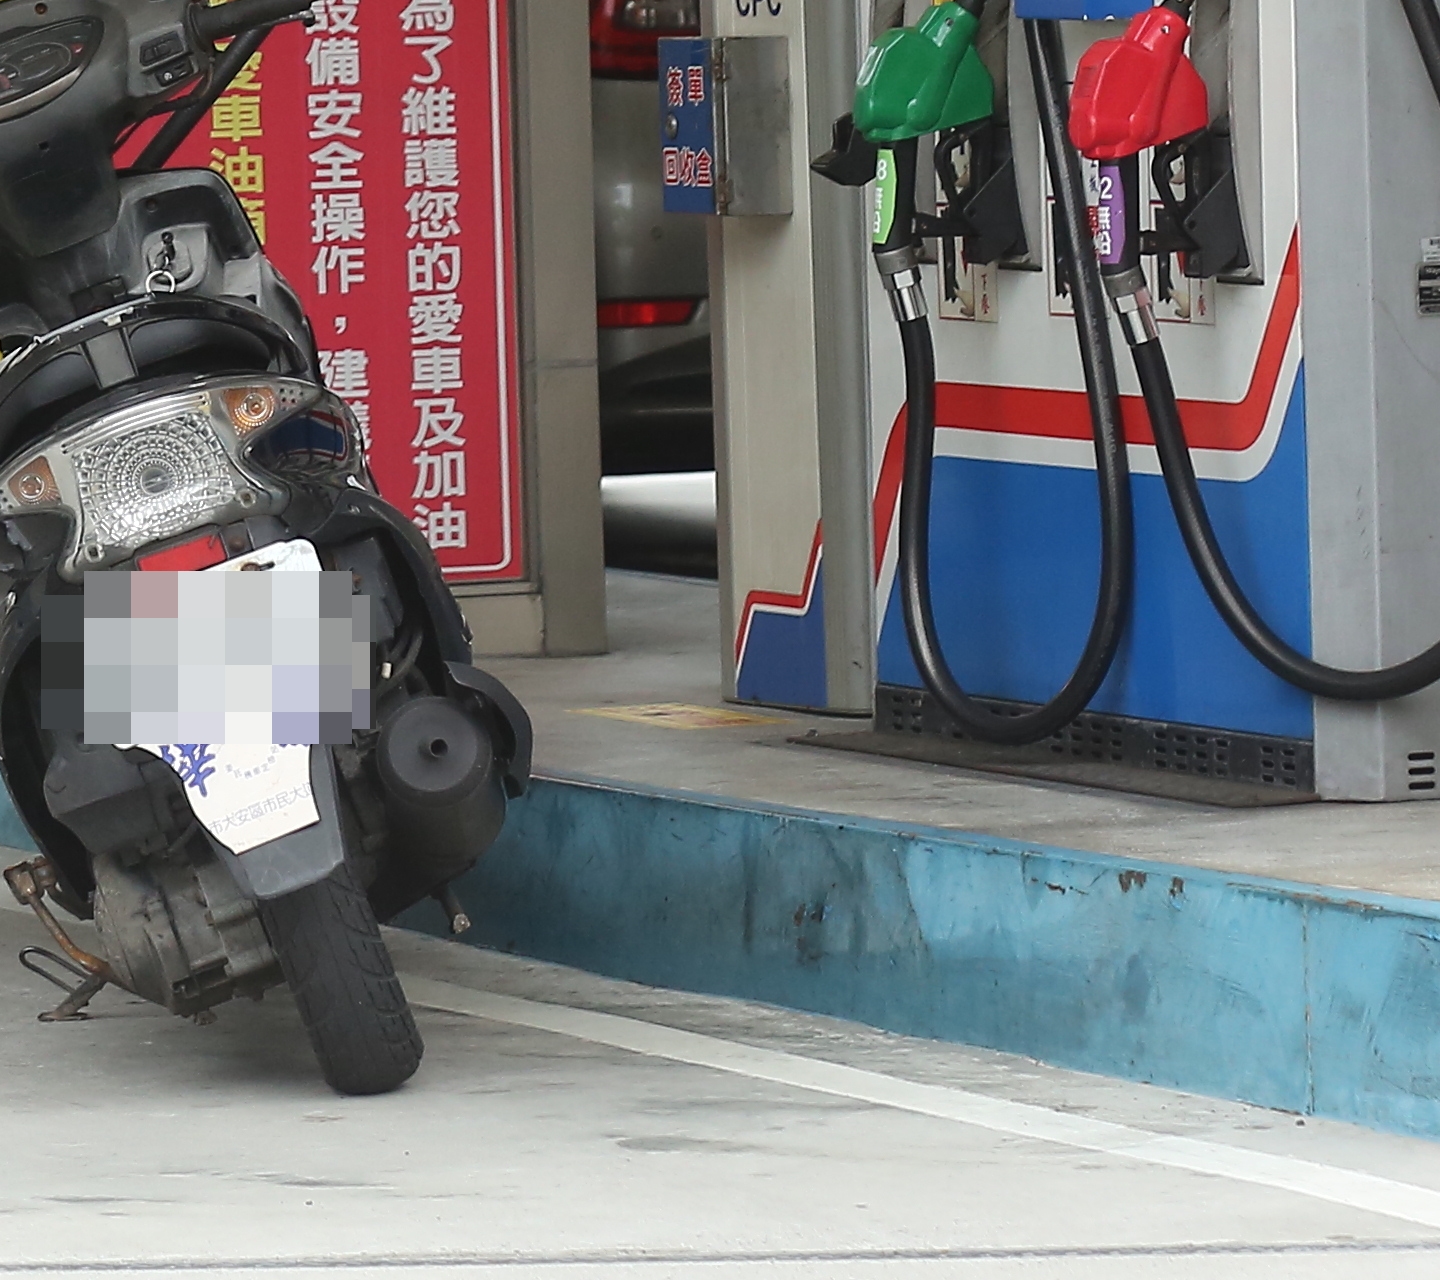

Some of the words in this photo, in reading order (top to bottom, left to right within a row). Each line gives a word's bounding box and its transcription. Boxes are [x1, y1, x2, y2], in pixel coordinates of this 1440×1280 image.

[665, 64, 705, 108] 簽單
[662, 145, 713, 191] 回收盒
